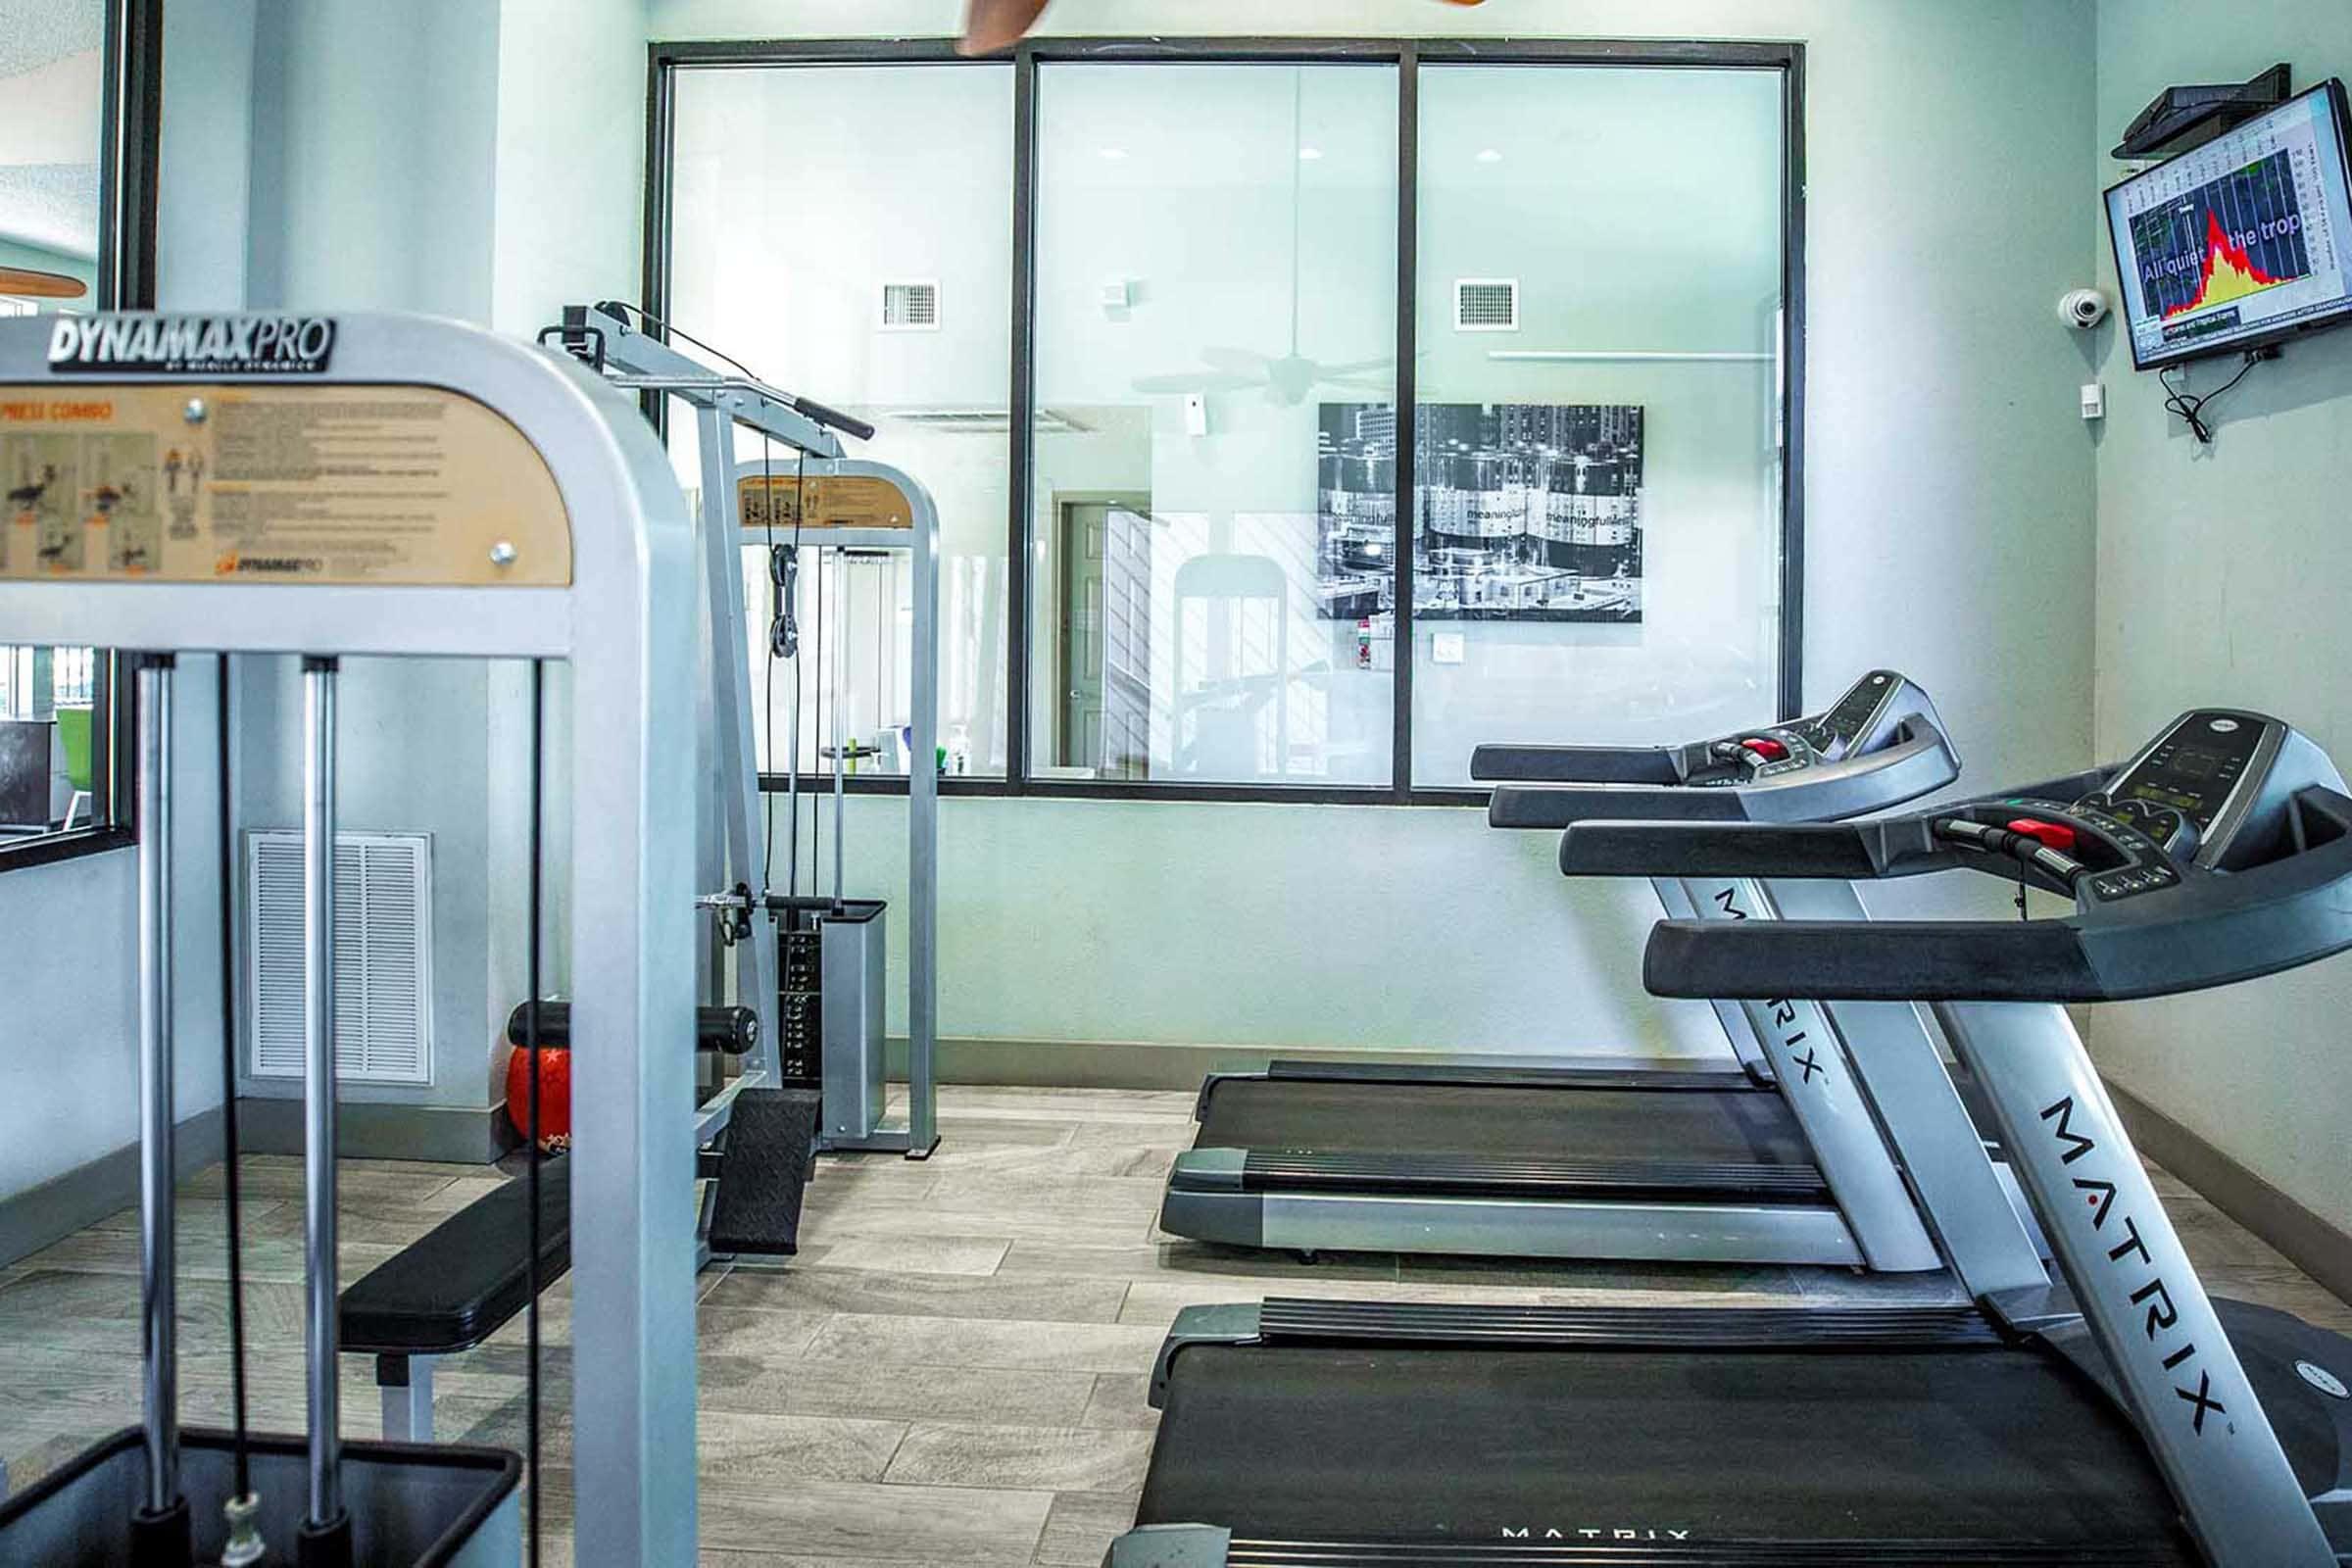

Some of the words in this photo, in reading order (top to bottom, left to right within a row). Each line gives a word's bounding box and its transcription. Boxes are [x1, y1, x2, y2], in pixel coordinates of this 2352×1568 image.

[2143, 261, 2164, 283] All
[2166, 247, 2205, 275] quiet
[2229, 229, 2257, 251] the
[1715, 888, 1823, 1085] MRIX
[2040, 1097, 2226, 1437] MATRIX
